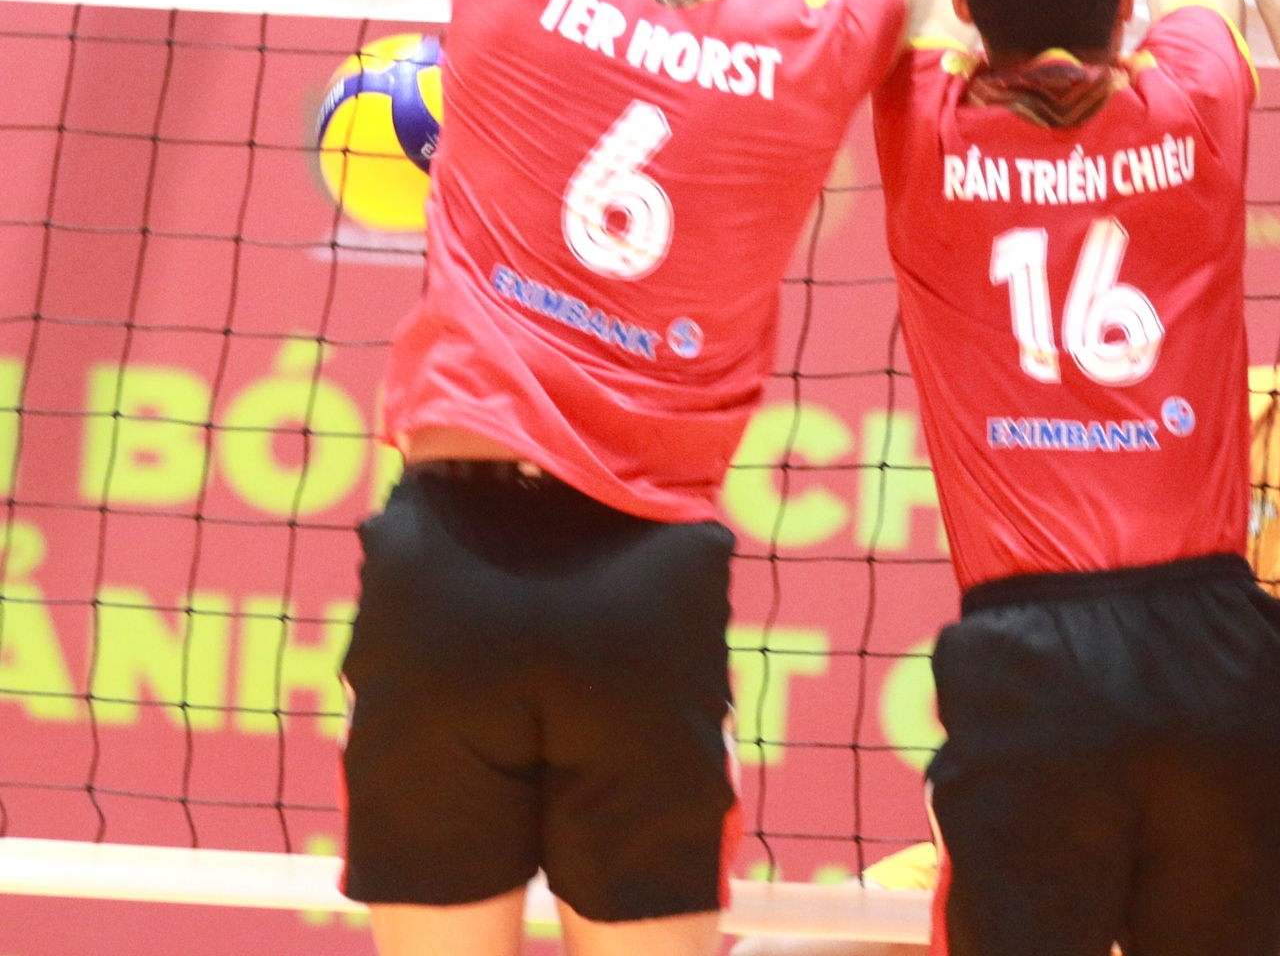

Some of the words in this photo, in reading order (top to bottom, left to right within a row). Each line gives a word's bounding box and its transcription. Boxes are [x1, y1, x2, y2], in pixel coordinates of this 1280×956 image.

[625, 17, 783, 101] HORST
[561, 98, 675, 282] 6
[943, 143, 1011, 203] RẦN
[489, 261, 664, 363] EXIMBANK
[988, 215, 1166, 388] 16
[79, 330, 404, 518] BÓ
[986, 415, 1161, 452] EXIMBANK
